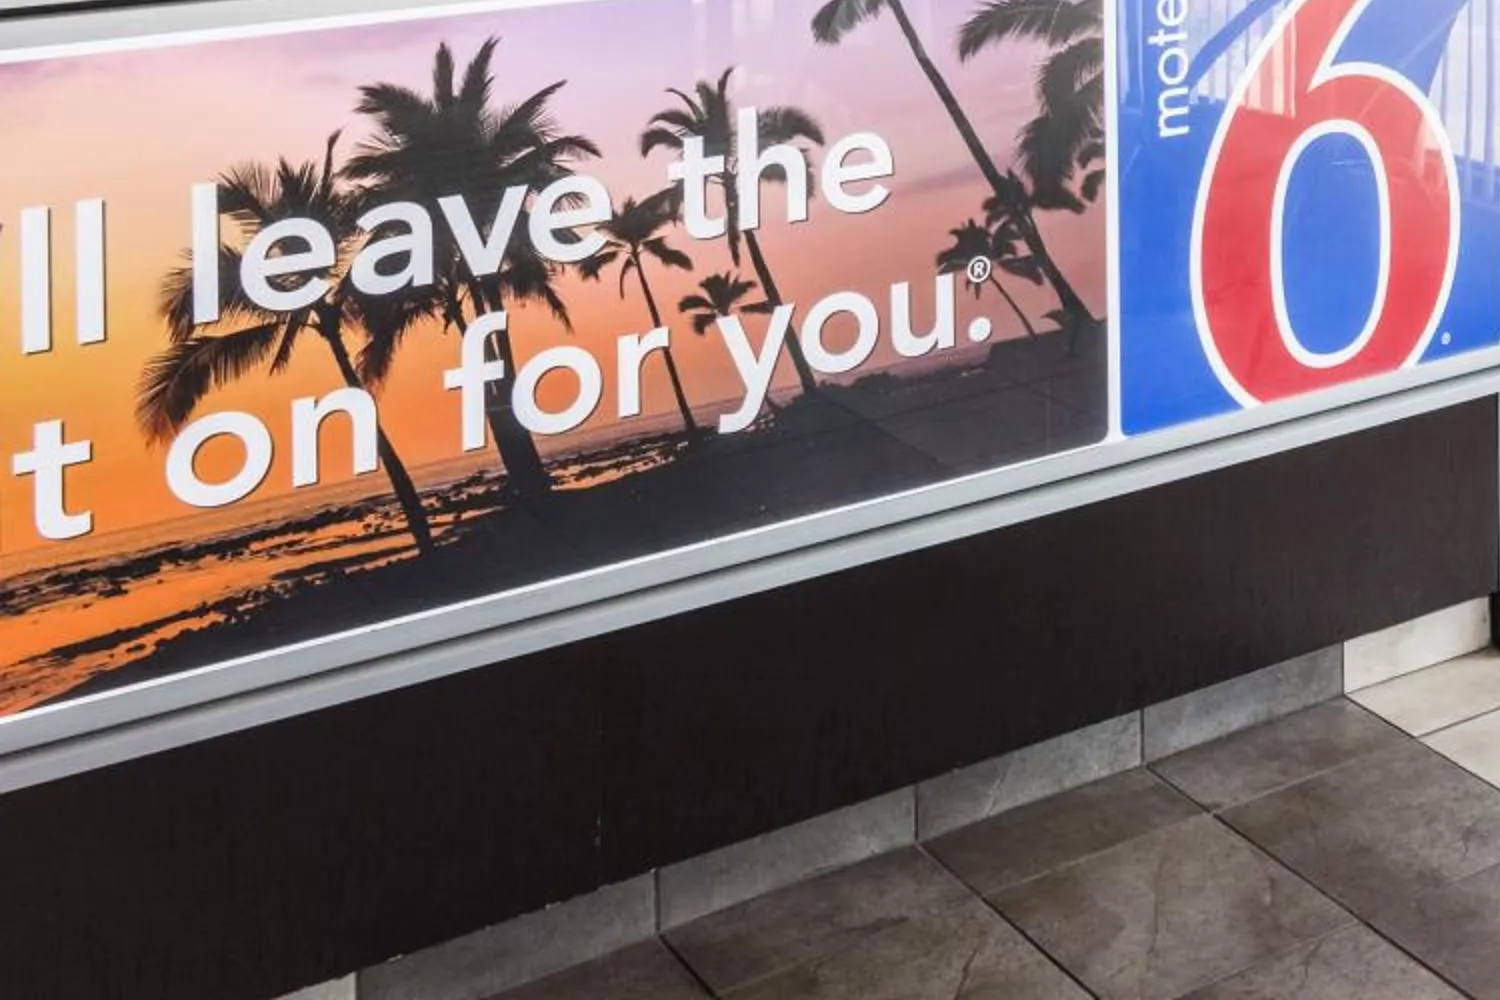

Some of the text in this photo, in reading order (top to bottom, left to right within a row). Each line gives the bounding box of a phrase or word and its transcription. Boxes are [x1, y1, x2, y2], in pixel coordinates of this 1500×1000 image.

[0, 106, 896, 354] ll leave the
[164, 385, 379, 508] on
[442, 311, 670, 452] for
